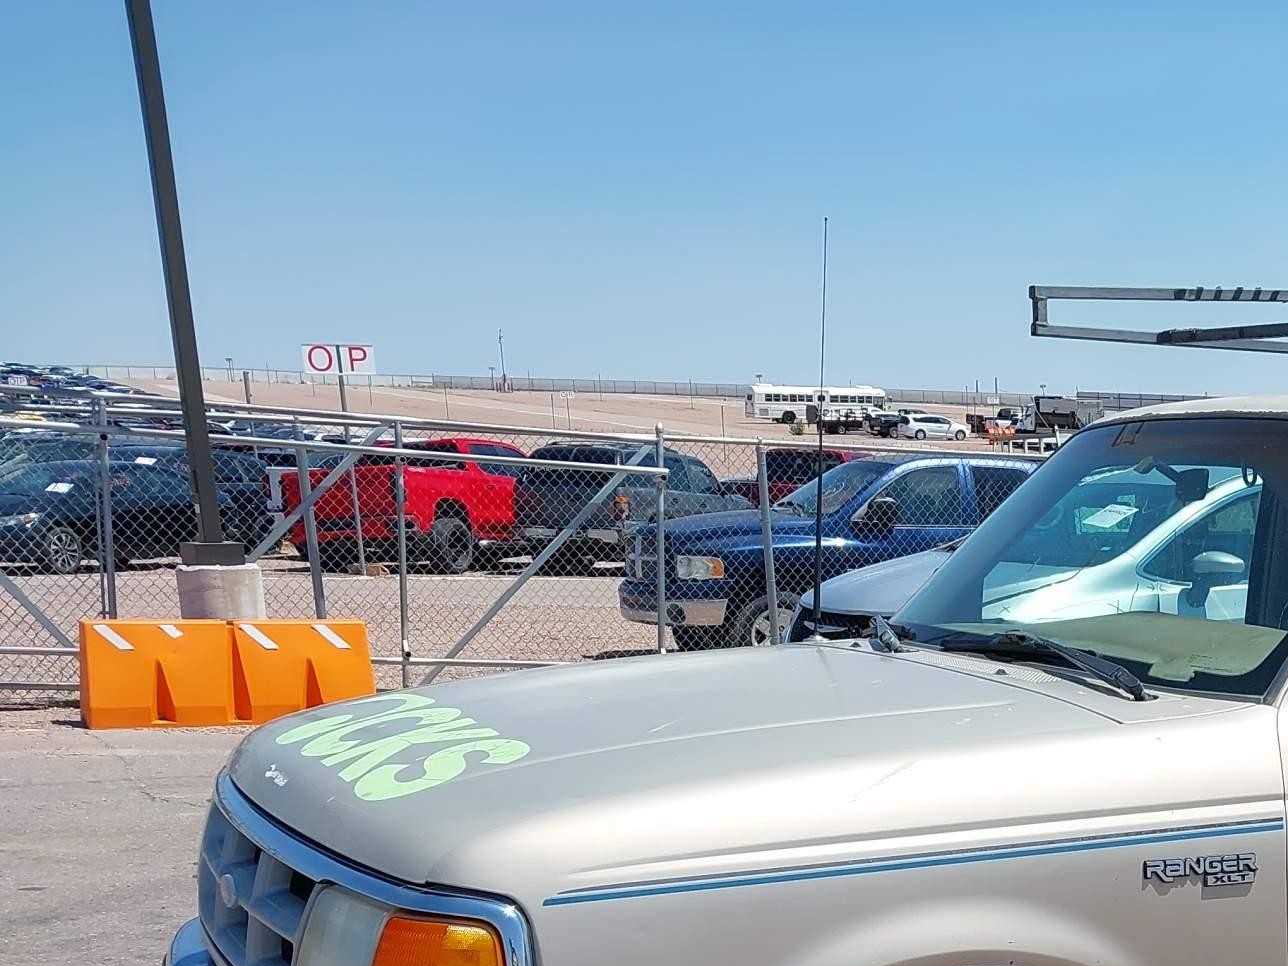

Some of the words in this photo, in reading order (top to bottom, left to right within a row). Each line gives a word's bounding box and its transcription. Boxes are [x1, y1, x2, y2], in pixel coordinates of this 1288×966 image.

[307, 345, 333, 372] O
[348, 346, 367, 372] P
[1143, 852, 1258, 883] RANGER
[1207, 871, 1253, 886] XLT
